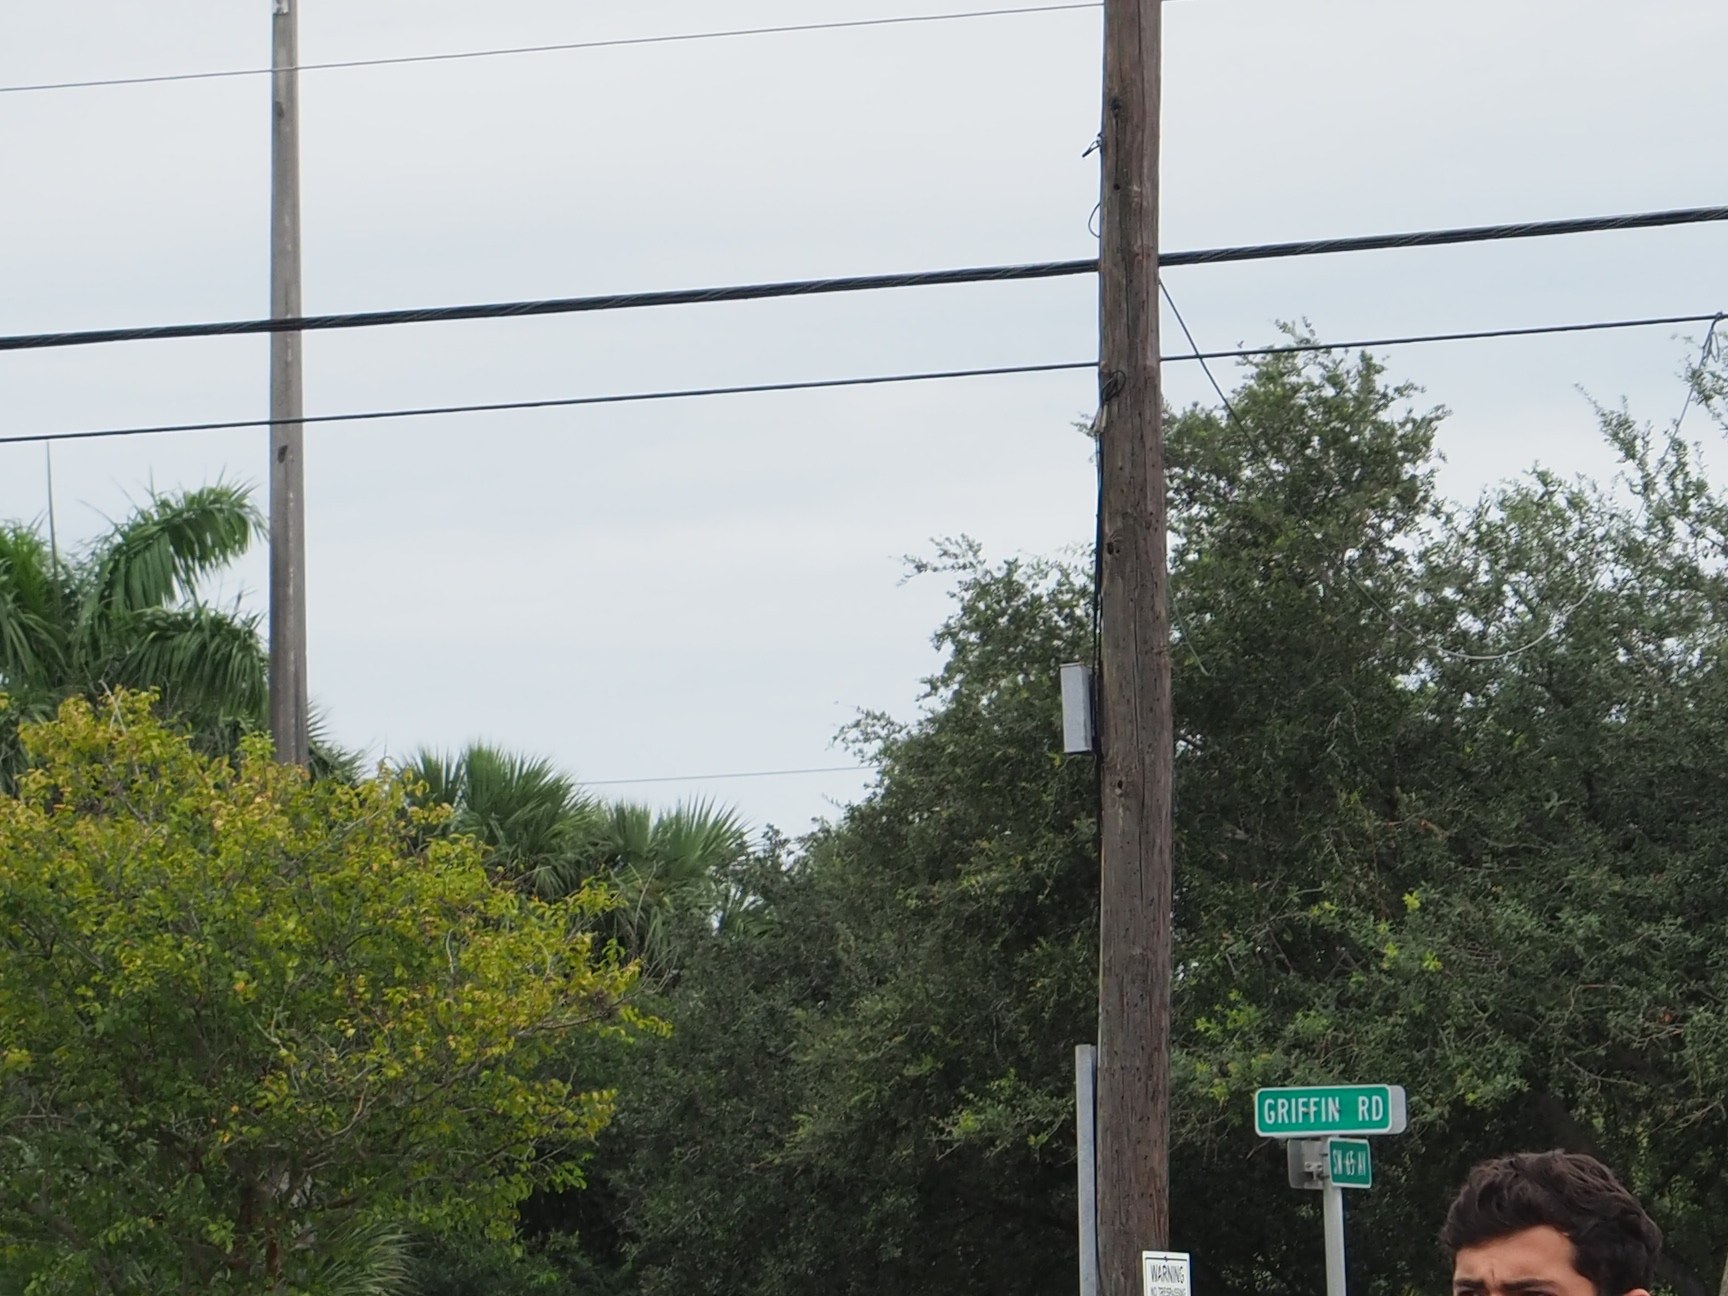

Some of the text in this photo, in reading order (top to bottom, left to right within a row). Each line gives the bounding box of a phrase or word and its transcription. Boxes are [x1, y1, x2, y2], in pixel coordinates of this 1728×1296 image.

[1263, 1095, 1384, 1125] GRIFFIN RD
[1150, 1264, 1185, 1284] WARNING
